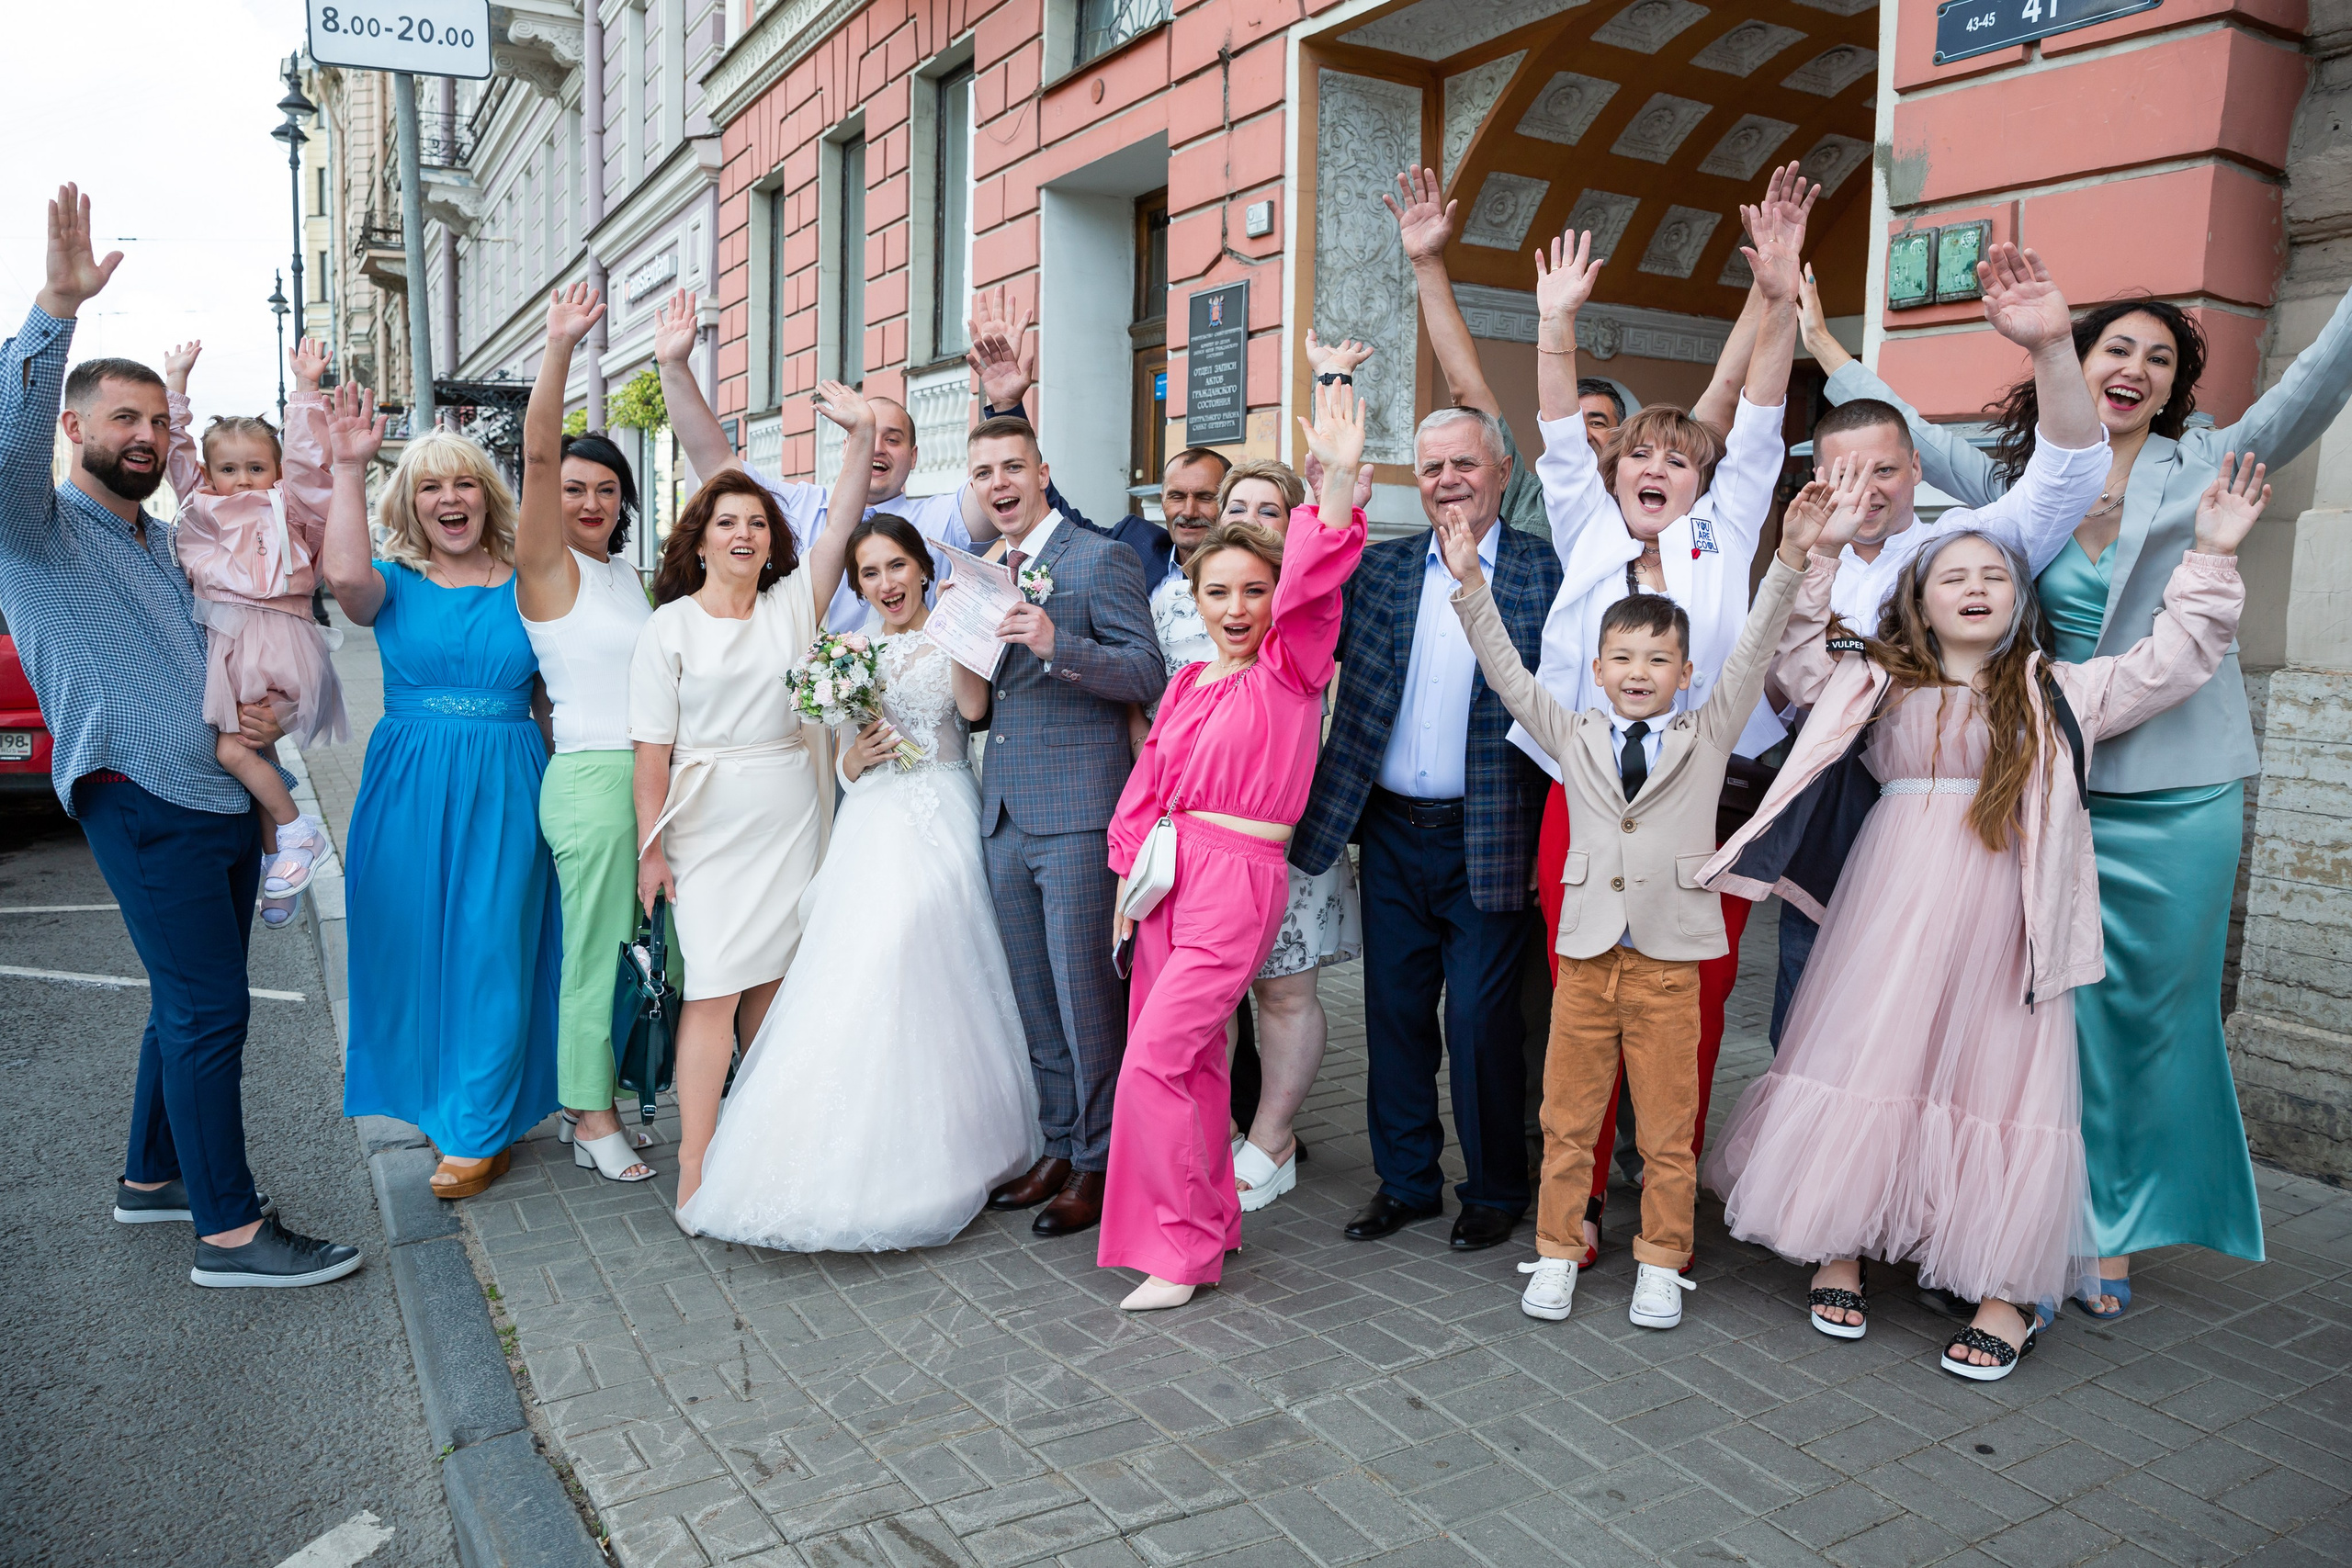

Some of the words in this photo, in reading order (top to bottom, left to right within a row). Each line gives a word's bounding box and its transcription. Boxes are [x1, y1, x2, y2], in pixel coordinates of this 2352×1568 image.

[322, 6, 474, 48] 8.00-20.00
[1965, 12, 1996, 32] 43-45
[1193, 366, 1212, 377] ОТДЕЛ
[1214, 361, 1237, 374] ЗАПИСИ
[1205, 375, 1224, 386] АКТОВ
[1192, 384, 1238, 400] ГРАЖДАНСКОГО
[1197, 397, 1231, 410] СОСТОЯНИЯ
[1695, 521, 1710, 532] YOU
[1698, 531, 1711, 541] ARE
[1696, 540, 1718, 551] COOL
[1832, 640, 1864, 650] VULPES
